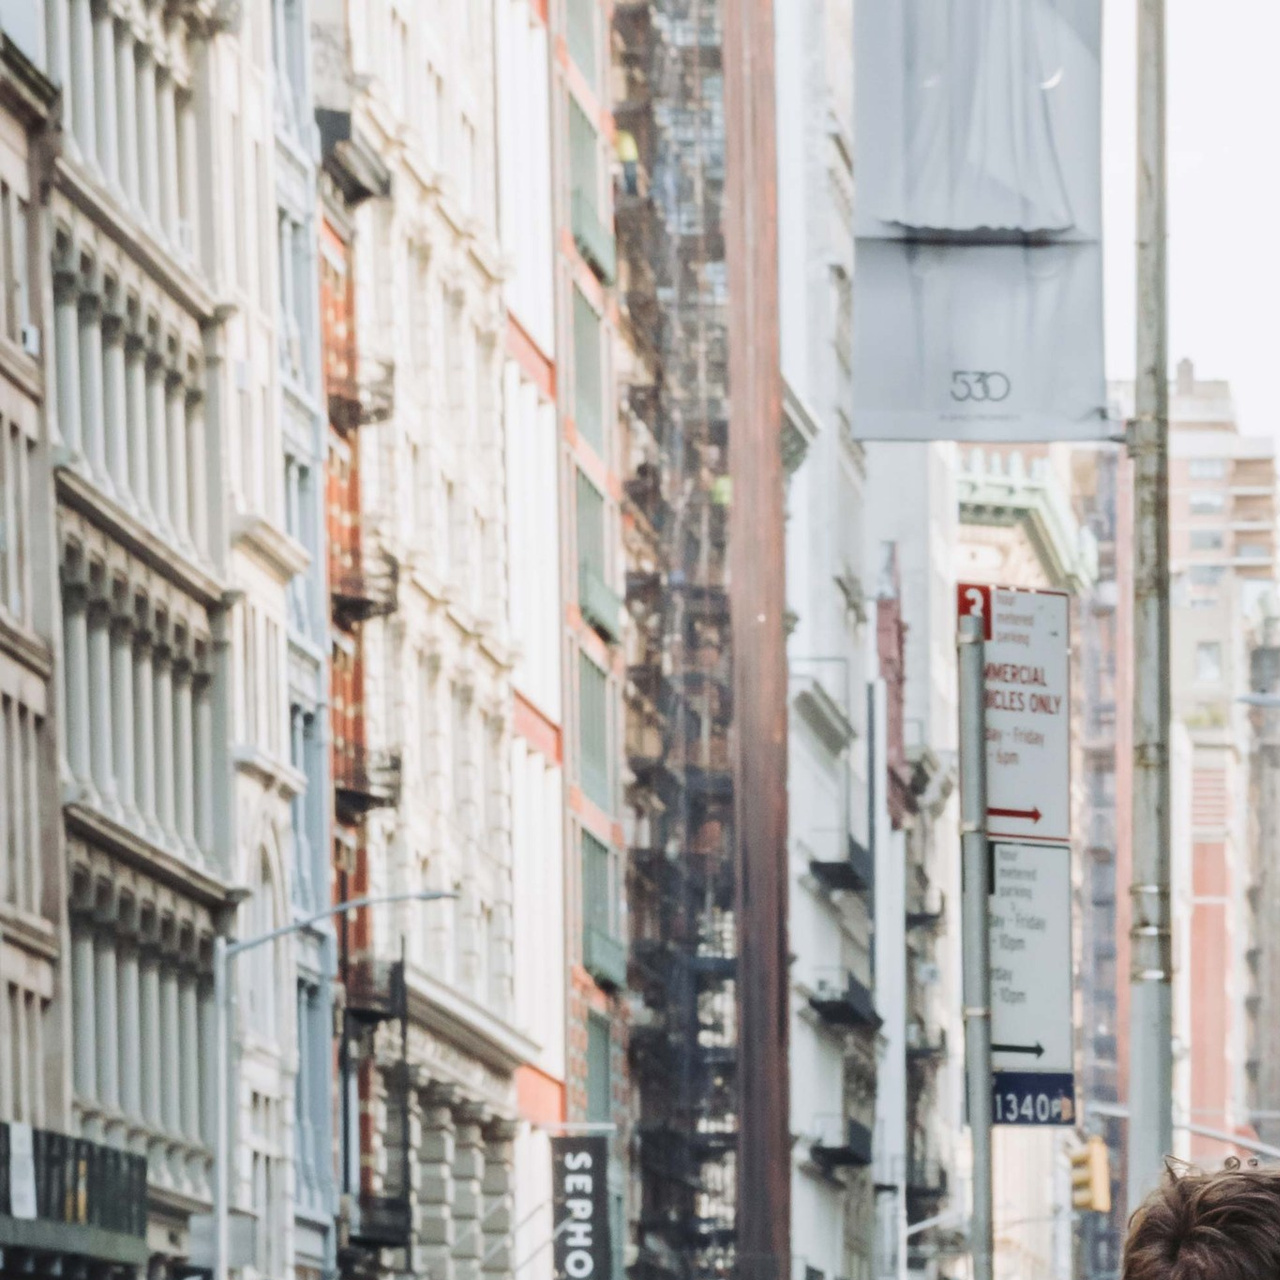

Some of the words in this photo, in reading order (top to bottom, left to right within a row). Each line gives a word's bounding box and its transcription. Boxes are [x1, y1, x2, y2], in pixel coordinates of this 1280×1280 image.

[950, 370, 1011, 401] 530
[985, 662, 1047, 687] MMERCIAL
[1030, 692, 1062, 715] ONLY
